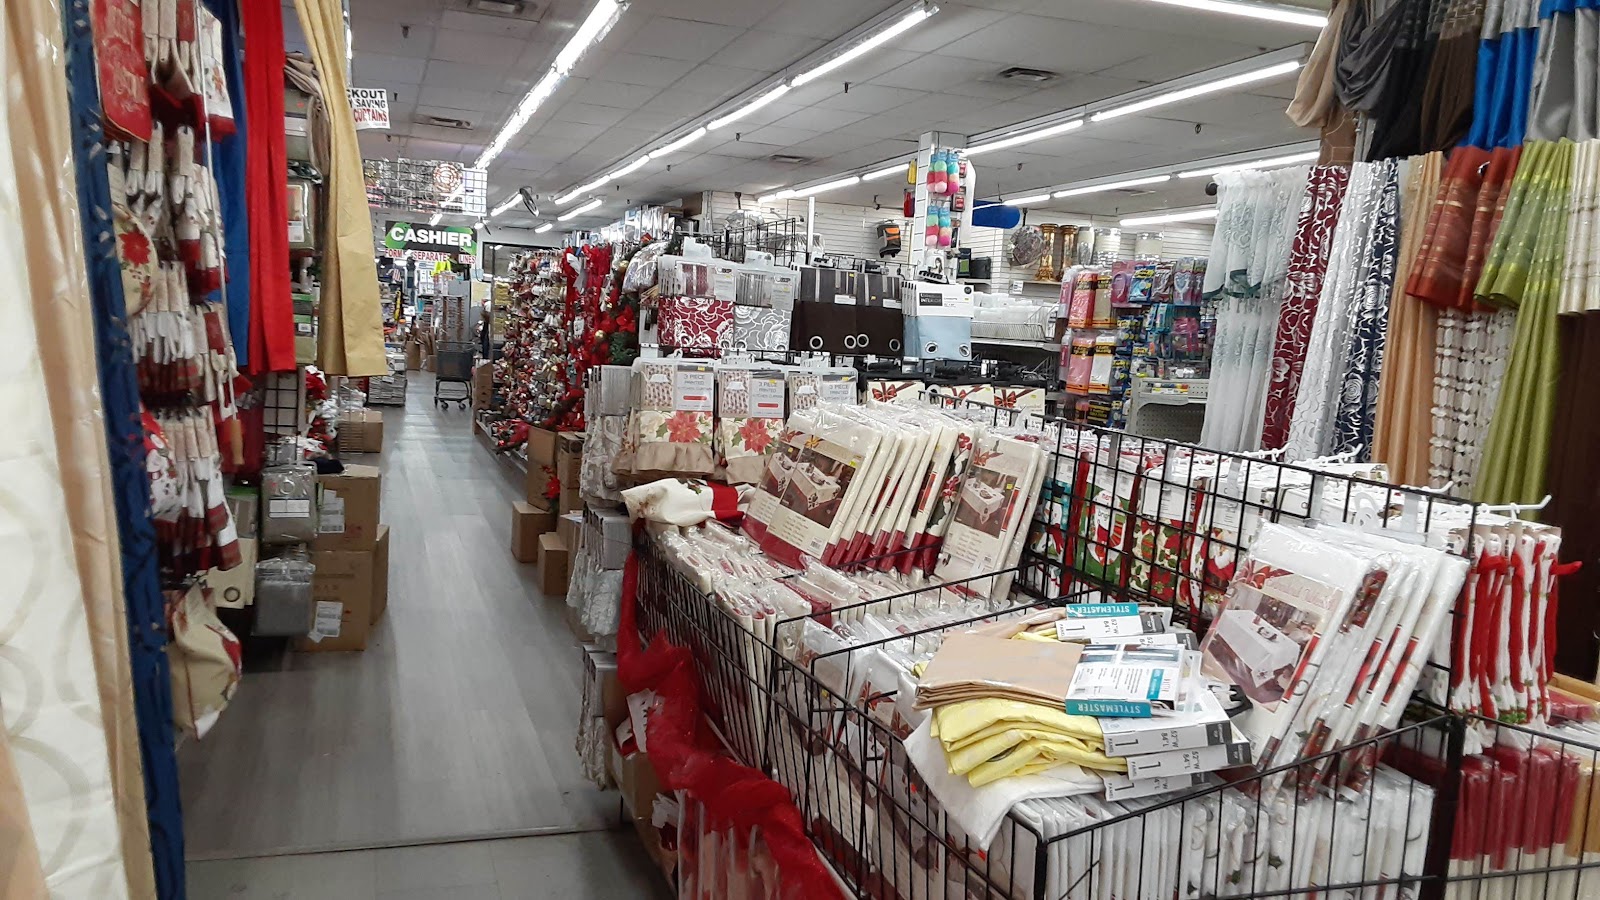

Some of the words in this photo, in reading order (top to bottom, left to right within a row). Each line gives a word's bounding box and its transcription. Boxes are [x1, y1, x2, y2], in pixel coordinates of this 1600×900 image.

[390, 227, 472, 247] CASHIER
[384, 248, 404, 257] FORM
[413, 251, 447, 261] SEPARATE
[459, 254, 476, 264] LINES
[1078, 605, 1130, 614] STYLEMASTER
[1077, 703, 1141, 714] STYLEMASTER
[1115, 738, 1139, 747] 1
[1161, 732, 1169, 748] 84"L
[1171, 730, 1179, 748] 52"W
[1138, 761, 1162, 770] 1
[1183, 753, 1191, 770] 84"L
[1192, 750, 1201, 770] 52"W
[1114, 782, 1135, 791] 1
